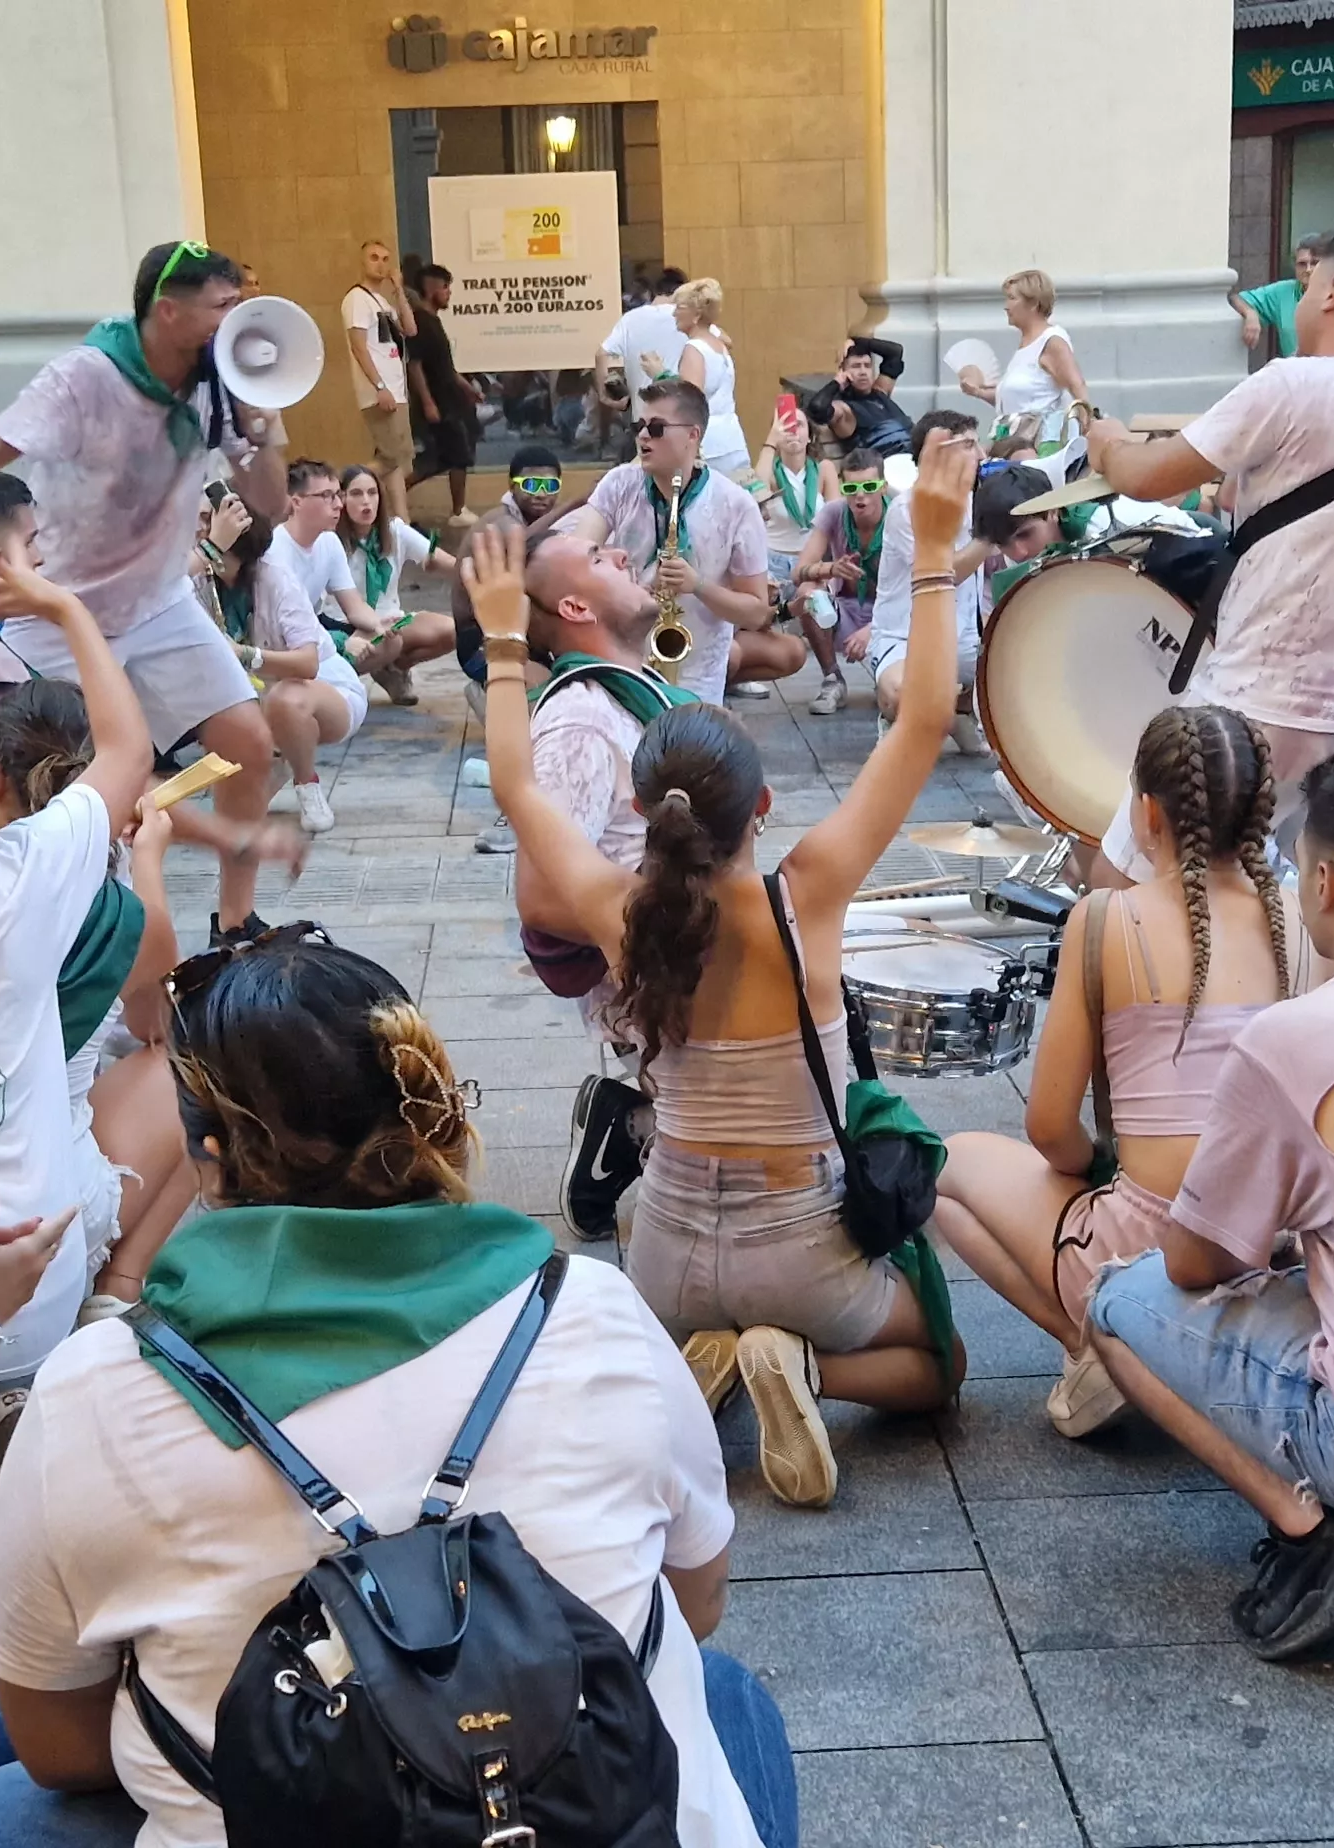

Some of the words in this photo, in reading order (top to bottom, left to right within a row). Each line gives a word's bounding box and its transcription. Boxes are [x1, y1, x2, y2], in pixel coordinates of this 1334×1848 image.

[463, 17, 657, 73] cajamar
[559, 61, 598, 75] CAJA
[603, 60, 653, 74] RURAL
[1291, 56, 1334, 76] CAJA
[1302, 79, 1320, 93] DE
[532, 212, 560, 229] 200
[463, 278, 497, 290] TRAE
[501, 277, 518, 289] TU
[494, 290, 504, 301] Y
[508, 288, 565, 301] LLEVATE
[453, 303, 499, 316] HASTA
[503, 301, 533, 314] 200
[537, 299, 604, 312] EURAZOS
